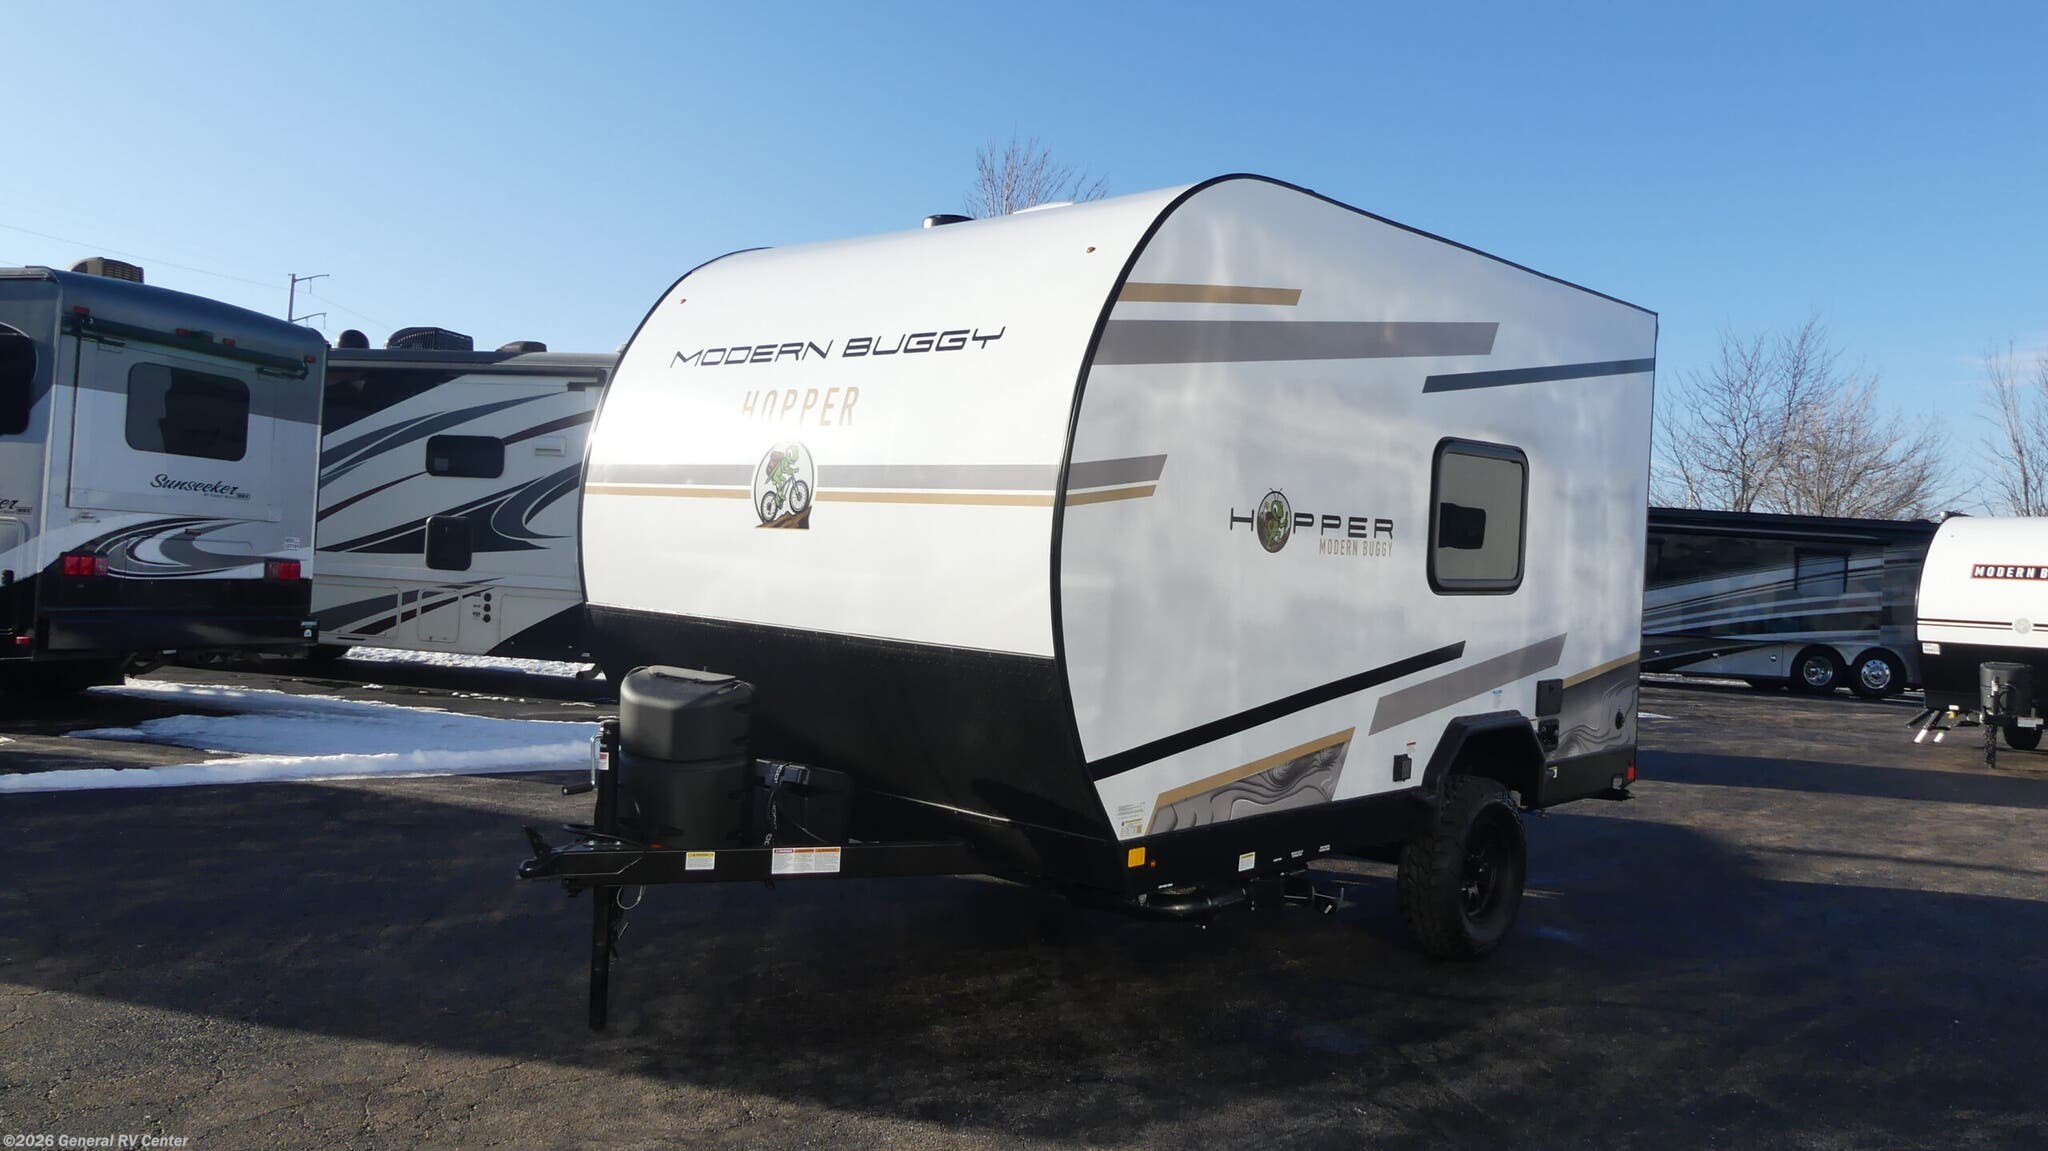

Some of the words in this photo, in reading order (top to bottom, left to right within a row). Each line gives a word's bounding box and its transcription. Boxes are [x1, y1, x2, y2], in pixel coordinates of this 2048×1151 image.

[669, 339, 834, 368] MODERN
[842, 326, 1006, 358] BUGGY
[741, 386, 860, 427] HOPPER
[150, 473, 239, 495] Sunseeker
[1319, 538, 1358, 557] MODERN
[1362, 540, 1393, 558] BUGGY
[1974, 566, 2036, 578] MODERN
